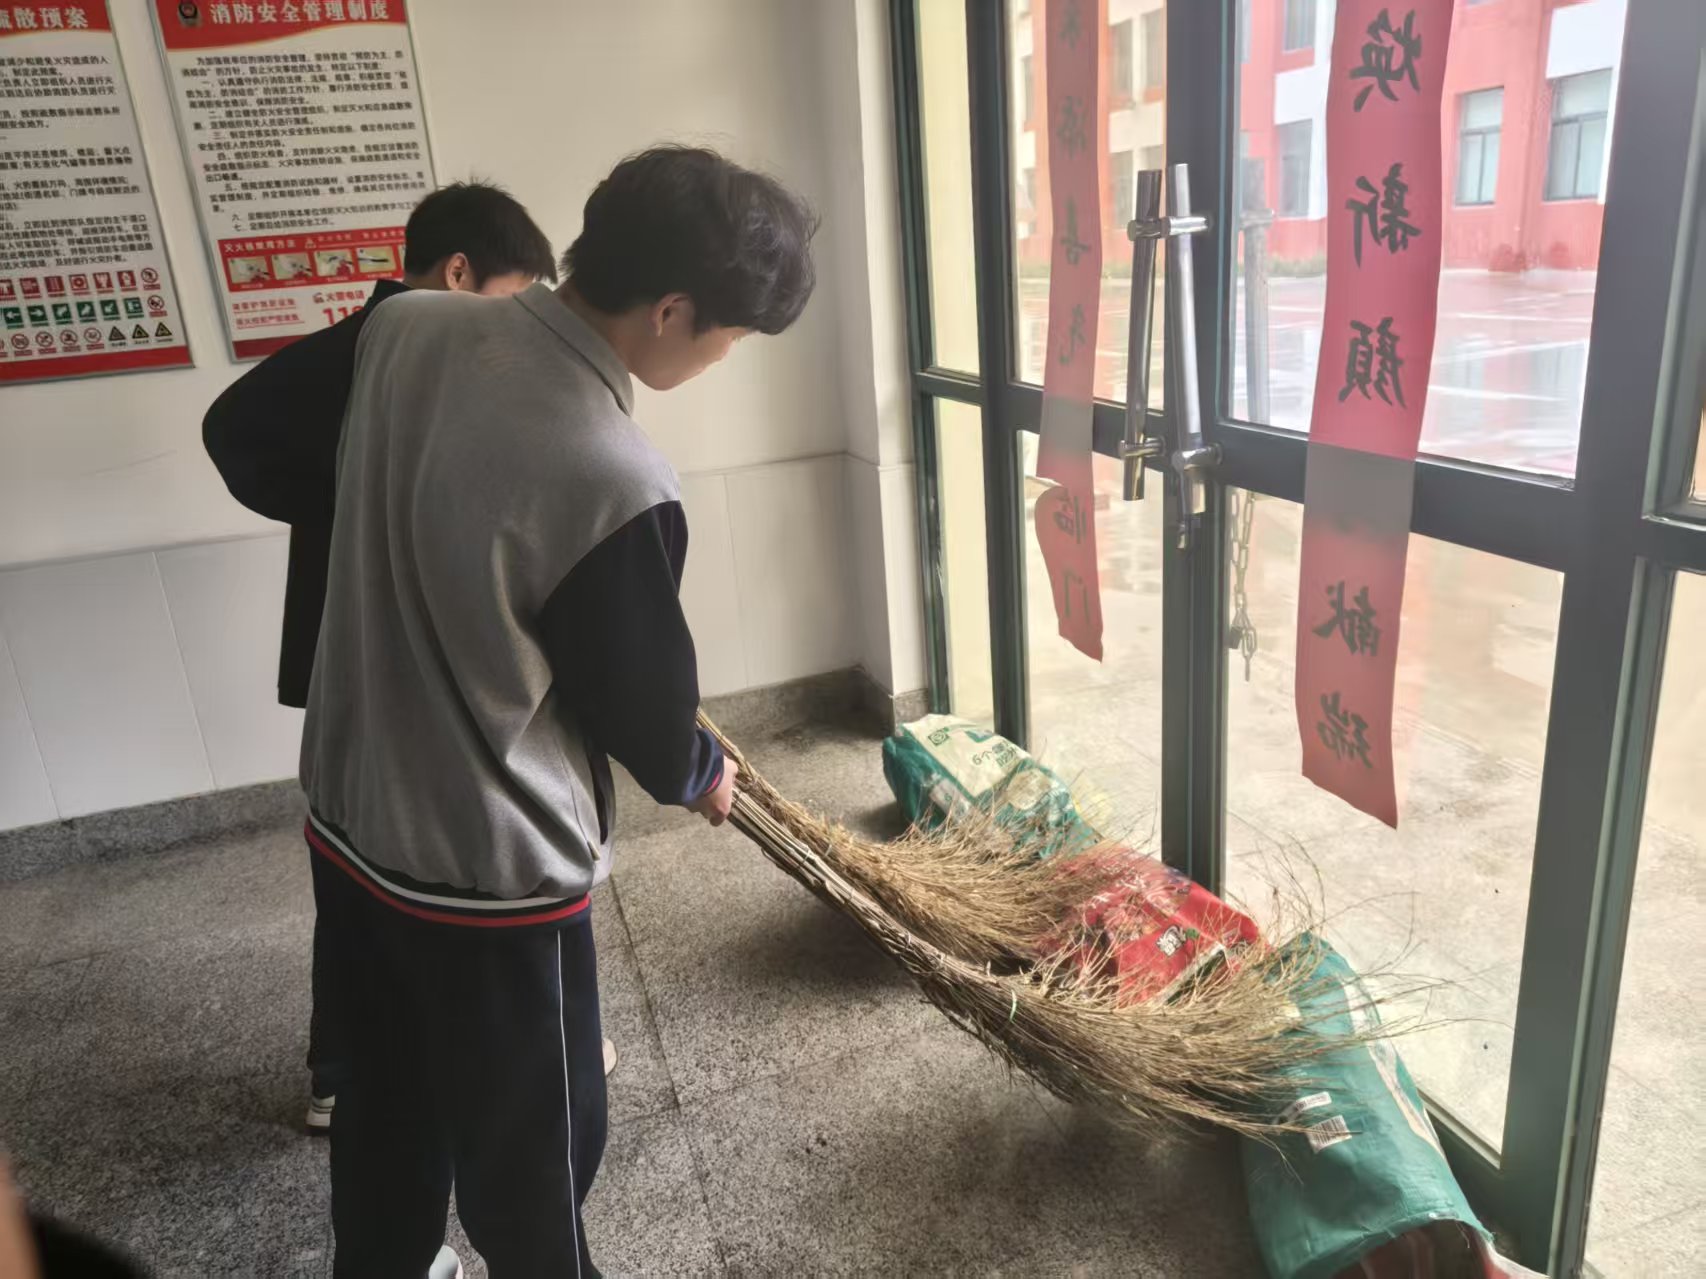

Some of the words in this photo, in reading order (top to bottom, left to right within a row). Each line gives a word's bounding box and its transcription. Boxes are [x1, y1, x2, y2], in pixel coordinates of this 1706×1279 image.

[210, 0, 390, 25] 消防安全管理制度
